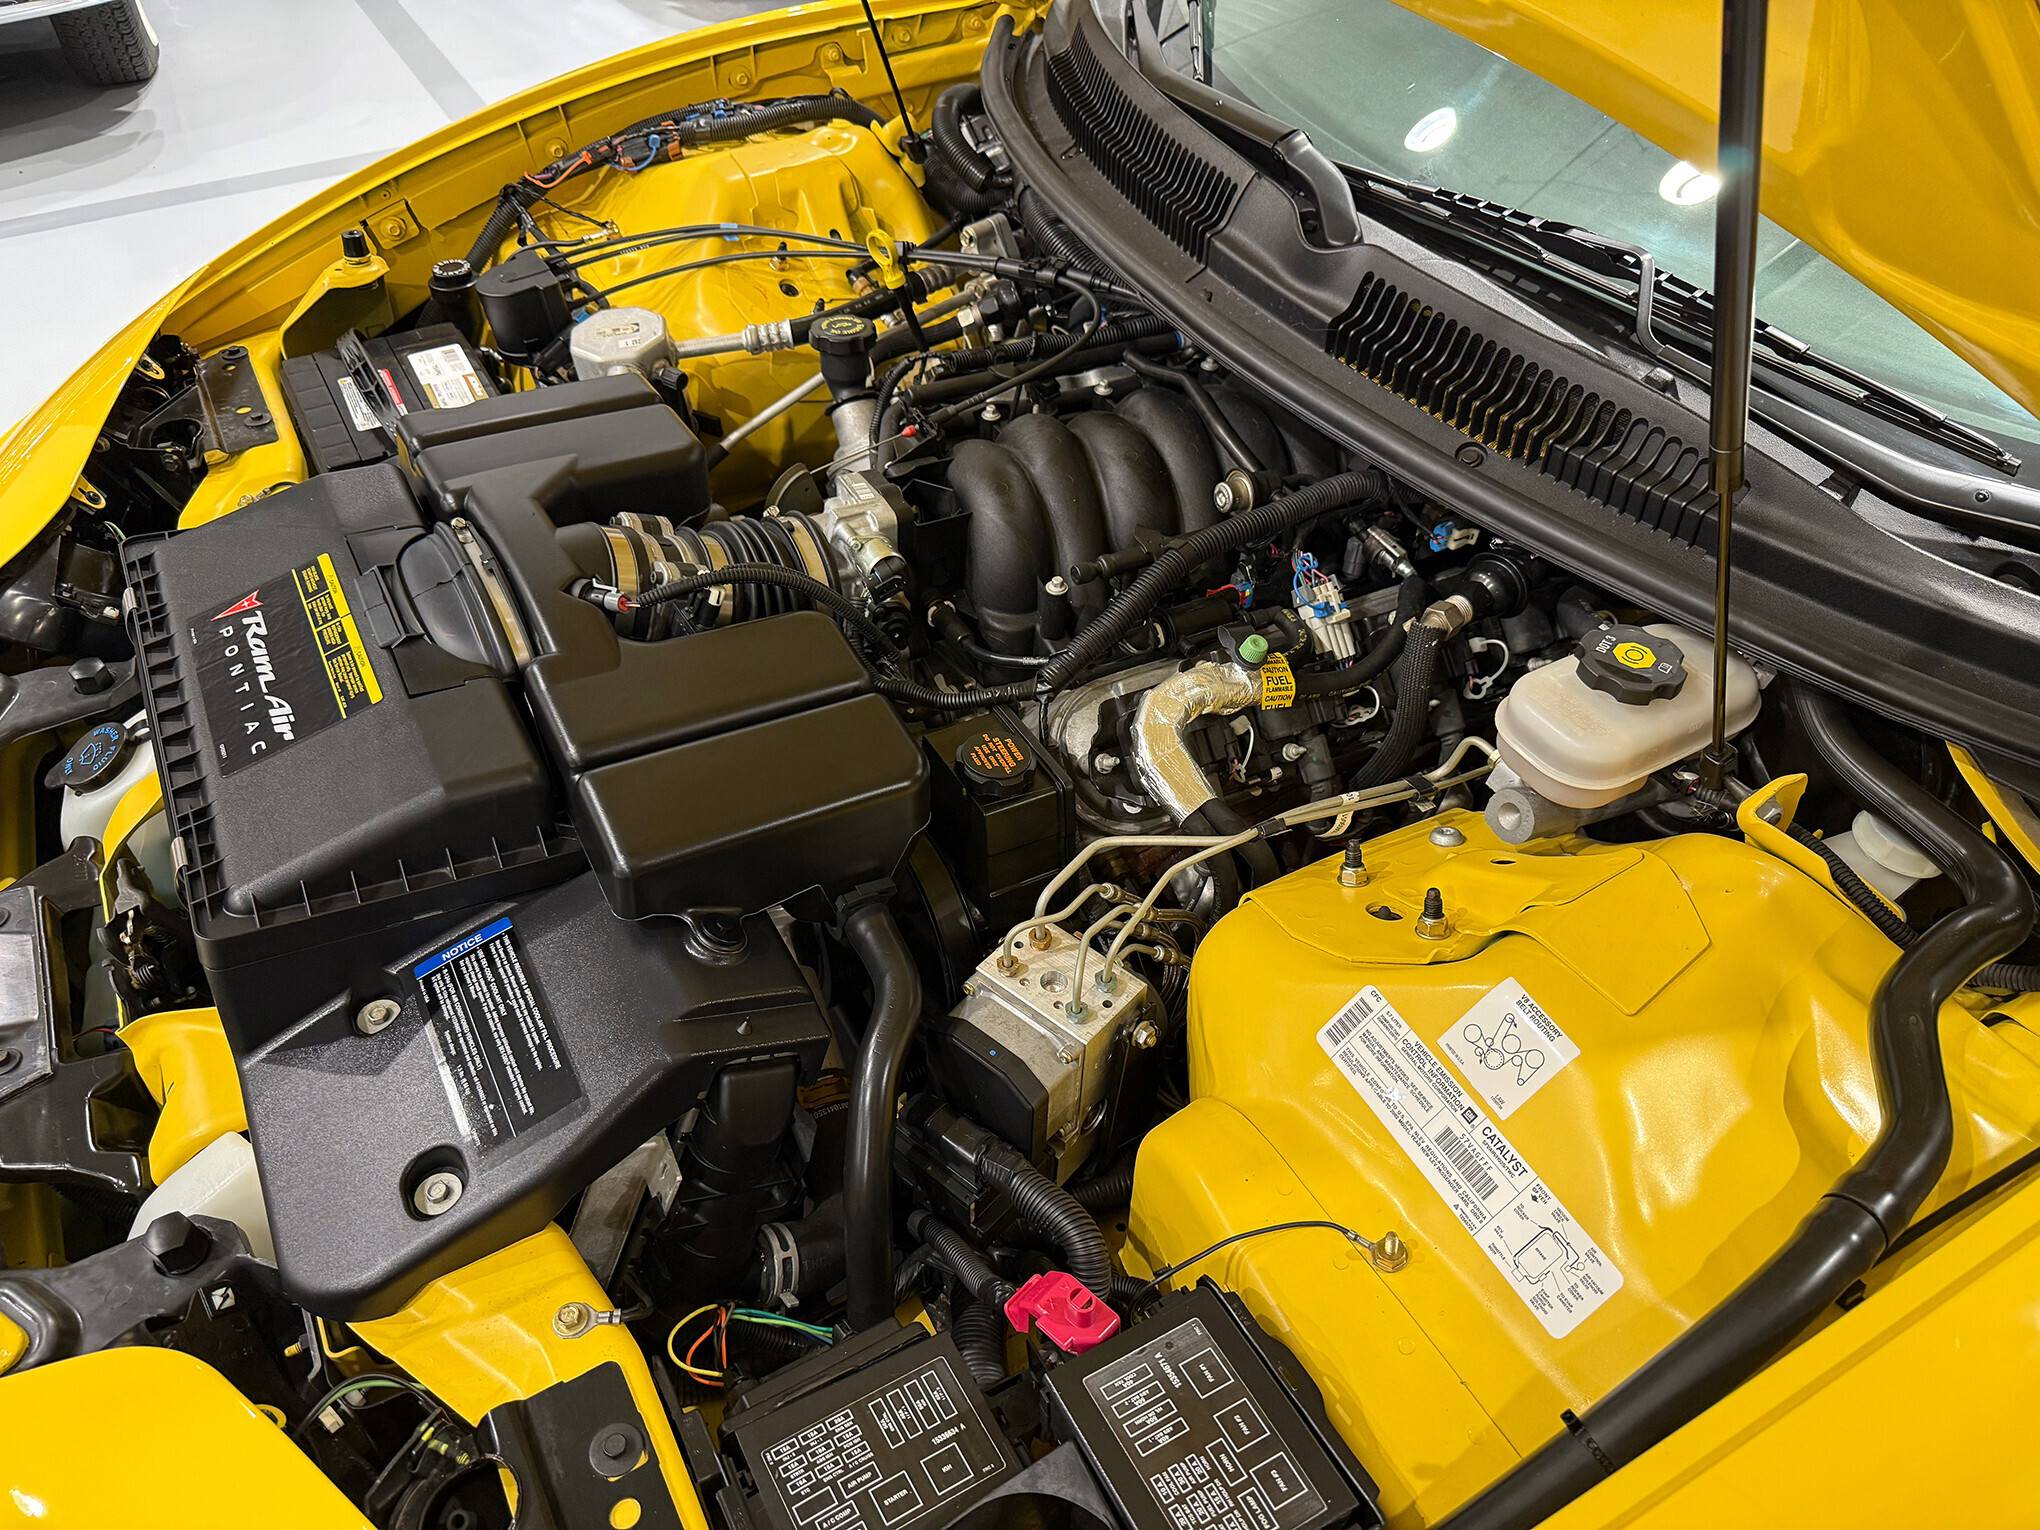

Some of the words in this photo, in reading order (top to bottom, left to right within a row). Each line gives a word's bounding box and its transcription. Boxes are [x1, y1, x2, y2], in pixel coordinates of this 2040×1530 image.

[1595, 639, 1613, 654] DOT
[242, 611, 275, 696] Ram
[264, 695, 295, 740] Air
[1265, 676, 1292, 685] FUEL
[219, 626, 266, 754] PONTIAC
[1264, 694, 1292, 702] CAUTION
[93, 727, 119, 742] WASHER
[92, 745, 117, 771] FLUID
[992, 737, 1017, 768] STEERING
[1004, 738, 1024, 761] POWER
[441, 933, 482, 961] NOTICE
[489, 981, 502, 1004] COOLANT
[1370, 989, 1382, 1003] CFC
[506, 944, 518, 963] VEHICLE
[513, 961, 527, 985] REQUIRES
[524, 987, 536, 1007] SPECIAL
[531, 1006, 545, 1030] COOLANT
[544, 1038, 561, 1069] PROCEDURE
[1514, 998, 1532, 1016] BELT
[1528, 1014, 1556, 1042] ROUTING
[1519, 994, 1530, 1004] V8
[1527, 1002, 1563, 1039] ACCESSORY
[1358, 1034, 1366, 1044] FOR
[1365, 1043, 1376, 1056] MORE
[1361, 1031, 1377, 1049] MANUAL
[1376, 1049, 1385, 1059] AND
[1383, 1058, 1411, 1090] MAINTENANCE
[1409, 1089, 1430, 1113] SCHEDULE
[1370, 1034, 1395, 1064] ADJUSTMENTS
[1417, 1092, 1433, 1110] SERVICE
[1401, 1037, 1428, 1068] CONTROL
[1427, 1068, 1464, 1111] INFORMATION
[1413, 1041, 1437, 1068] VEHICLE
[1435, 1066, 1463, 1097] EMISSION
[1400, 1046, 1418, 1066] GENERAL
[1416, 1065, 1433, 1083] MOTORS
[1431, 1081, 1458, 1113] CORPORATION
[1341, 1049, 1366, 1078] REGULATIONS
[1419, 1146, 1430, 1158] NEW
[1428, 1156, 1437, 1167] LEV
[1435, 1165, 1459, 1193] PASSENGER
[1345, 1046, 1355, 1058] THIS
[1354, 1057, 1370, 1077] VEHICLE
[1369, 1076, 1391, 1103] CONFOS
[1404, 1120, 1414, 1130] EPA
[1424, 1144, 1453, 1178] REGULATIONS
[1452, 1177, 1462, 1190] AND
[1461, 1189, 1487, 1220] CALIFORNIA
[1480, 1125, 1527, 1178] CATALYST
[1531, 1186, 1539, 1195] OF
[1537, 1193, 1547, 1204] VEH
[1535, 1183, 1551, 1201] FRONT
[1153, 1351, 1162, 1359] A
[1198, 1362, 1207, 1371] #1
[1203, 1369, 1215, 1382] FAN
[958, 1421, 966, 1430] A
[1233, 1413, 1242, 1423] #2
[1238, 1421, 1250, 1435] FAN
[941, 1463, 953, 1473] IGN
[1179, 1460, 1190, 1475] PUMP
[1194, 1465, 1203, 1475] 20
[1199, 1454, 1211, 1471] HORN
[1218, 1452, 1235, 1473] HORN
[846, 1479, 857, 1489] AIR
[856, 1471, 873, 1483] PUMP
[1269, 1468, 1279, 1479] #3
[1156, 1480, 1163, 1488] A
[1159, 1486, 1168, 1496] 10
[1275, 1476, 1288, 1492] FAN
[883, 1488, 908, 1506] STARTER
[1196, 1488, 1208, 1504] PUMP
[1209, 1489, 1217, 1497] A
[1192, 1500, 1199, 1508] A
[1196, 1506, 1204, 1516] 20
[1205, 1502, 1217, 1517] FUEL
[1245, 1493, 1261, 1514] LAMP
[834, 1507, 852, 1521] COMP
[1174, 1510, 1182, 1518] A
[1178, 1516, 1186, 1526] 20
[1257, 1512, 1270, 1529] FOG
